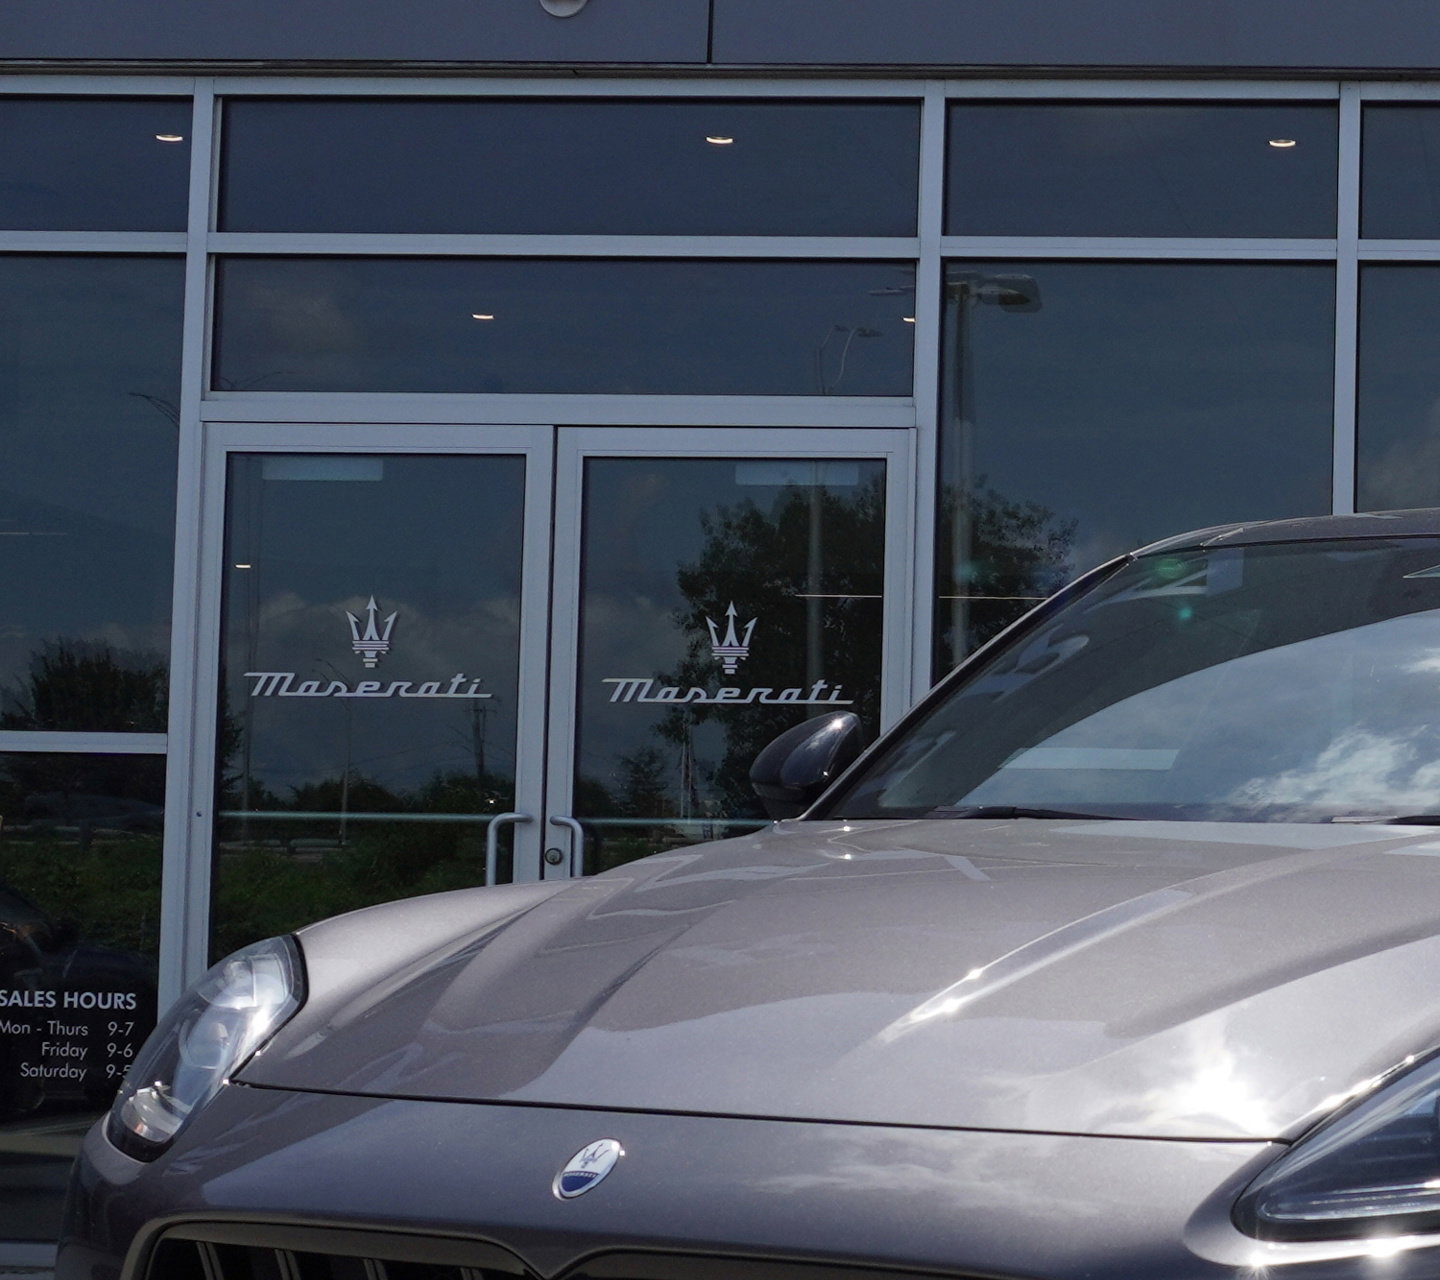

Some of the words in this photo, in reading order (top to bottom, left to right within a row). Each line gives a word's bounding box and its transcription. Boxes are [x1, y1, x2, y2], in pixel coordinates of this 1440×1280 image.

[244, 671, 493, 699] Maserati
[601, 677, 855, 706] Maserati
[63, 991, 137, 1011] HOURS
[46, 1019, 89, 1037] Thurs
[107, 1021, 135, 1037] 9-7
[41, 1041, 89, 1061] Friday
[106, 1042, 134, 1058] 9-6
[19, 1061, 88, 1082] Saturday
